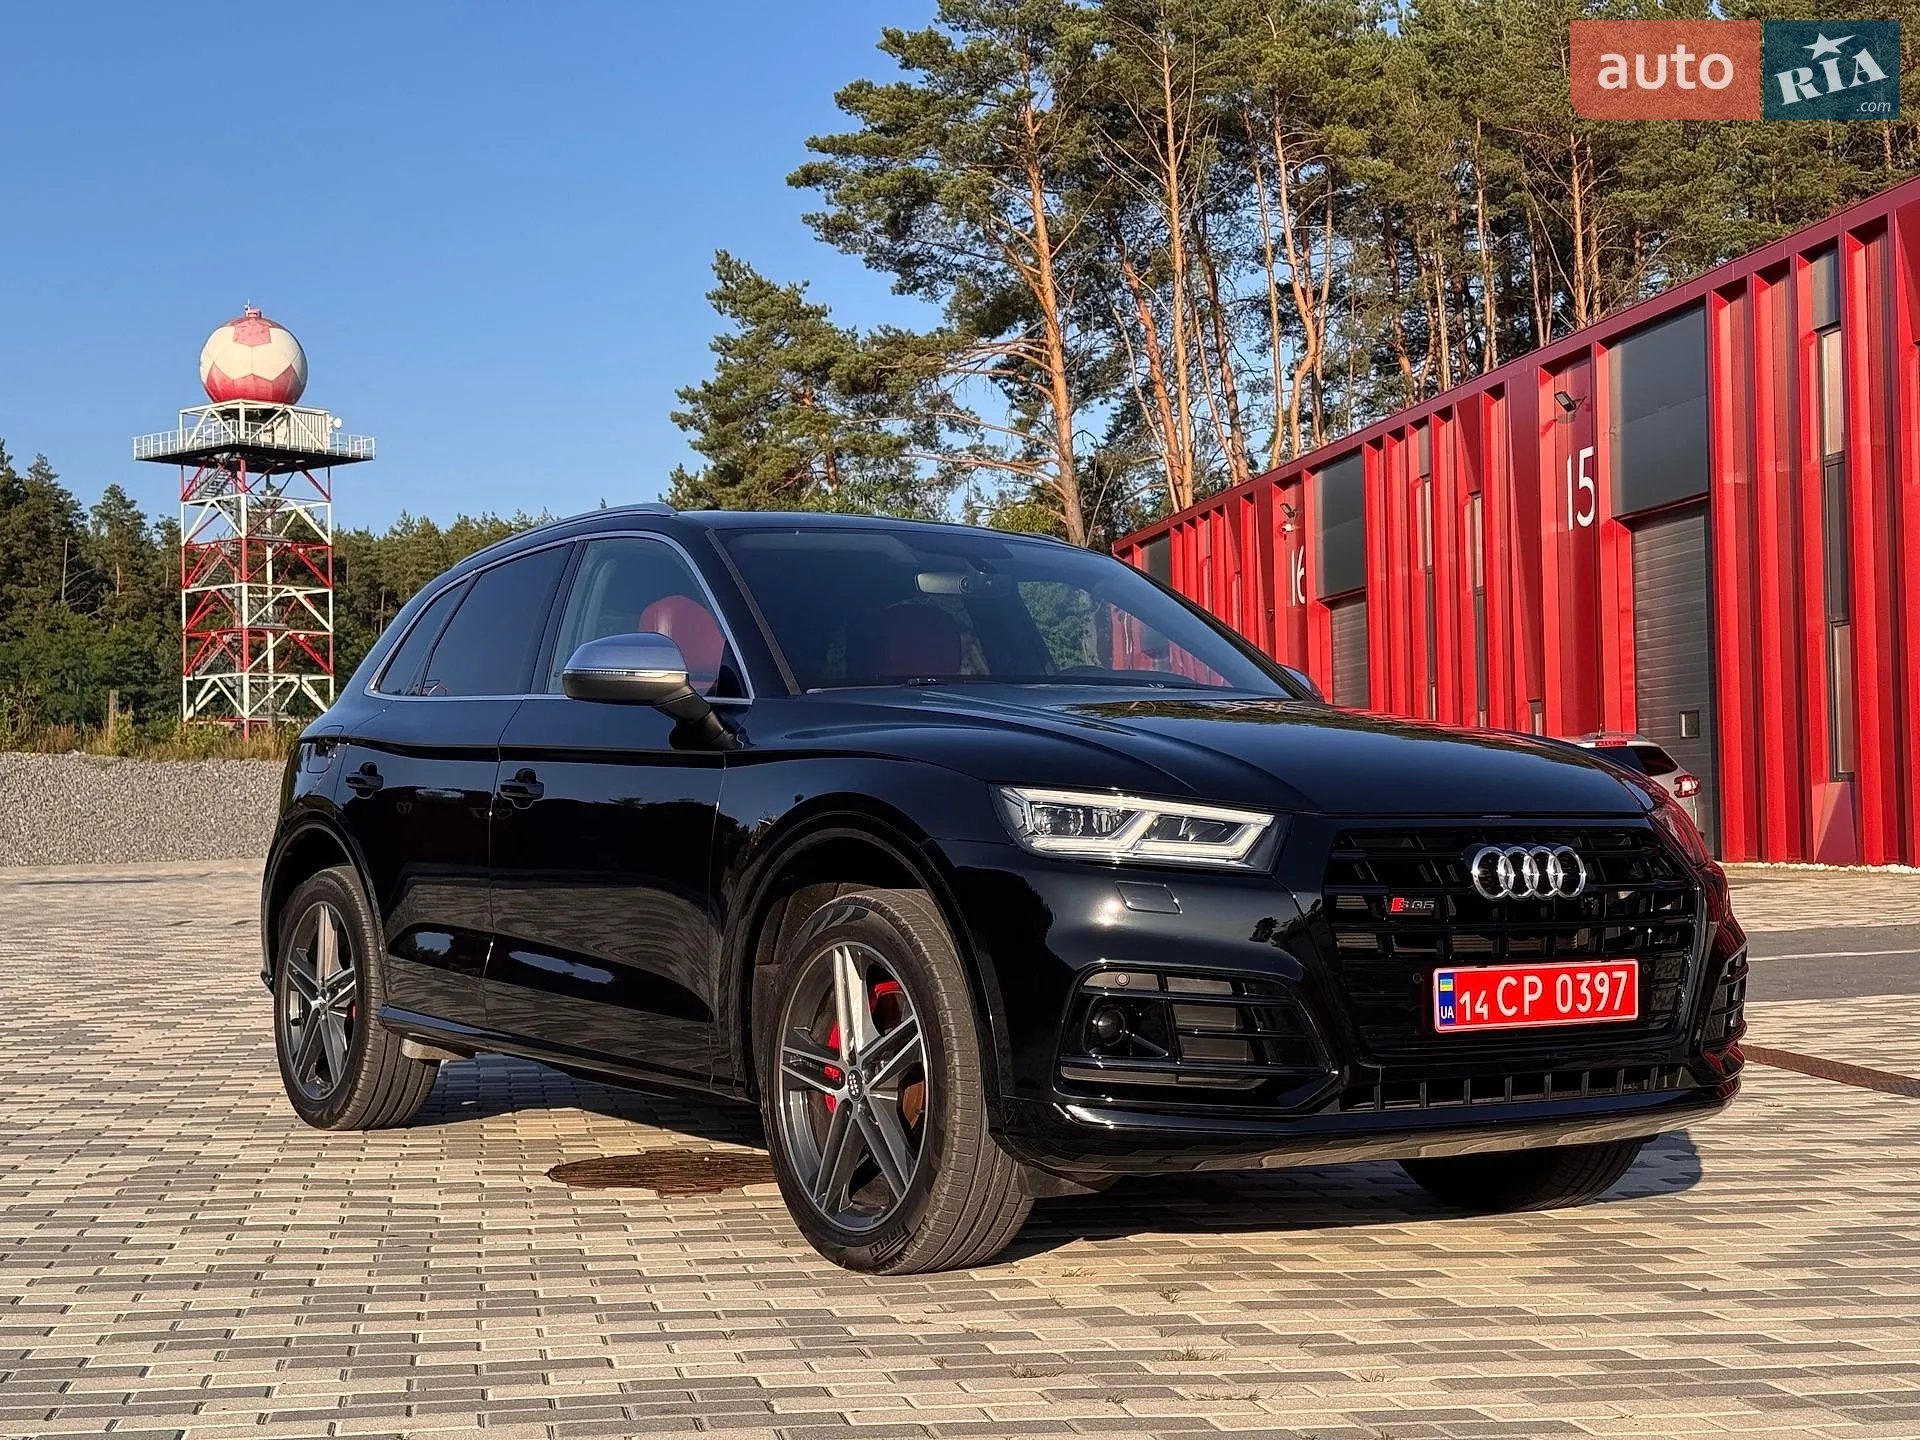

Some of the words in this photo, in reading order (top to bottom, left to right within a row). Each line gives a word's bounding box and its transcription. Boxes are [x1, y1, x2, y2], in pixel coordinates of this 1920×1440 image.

[1566, 446, 1596, 531] 15
[1290, 544, 1306, 607] 16
[1440, 1005, 1455, 1020] UA
[1458, 990, 1489, 1021] 14
[1496, 975, 1543, 1017] CP
[1554, 970, 1628, 1014] 0397
